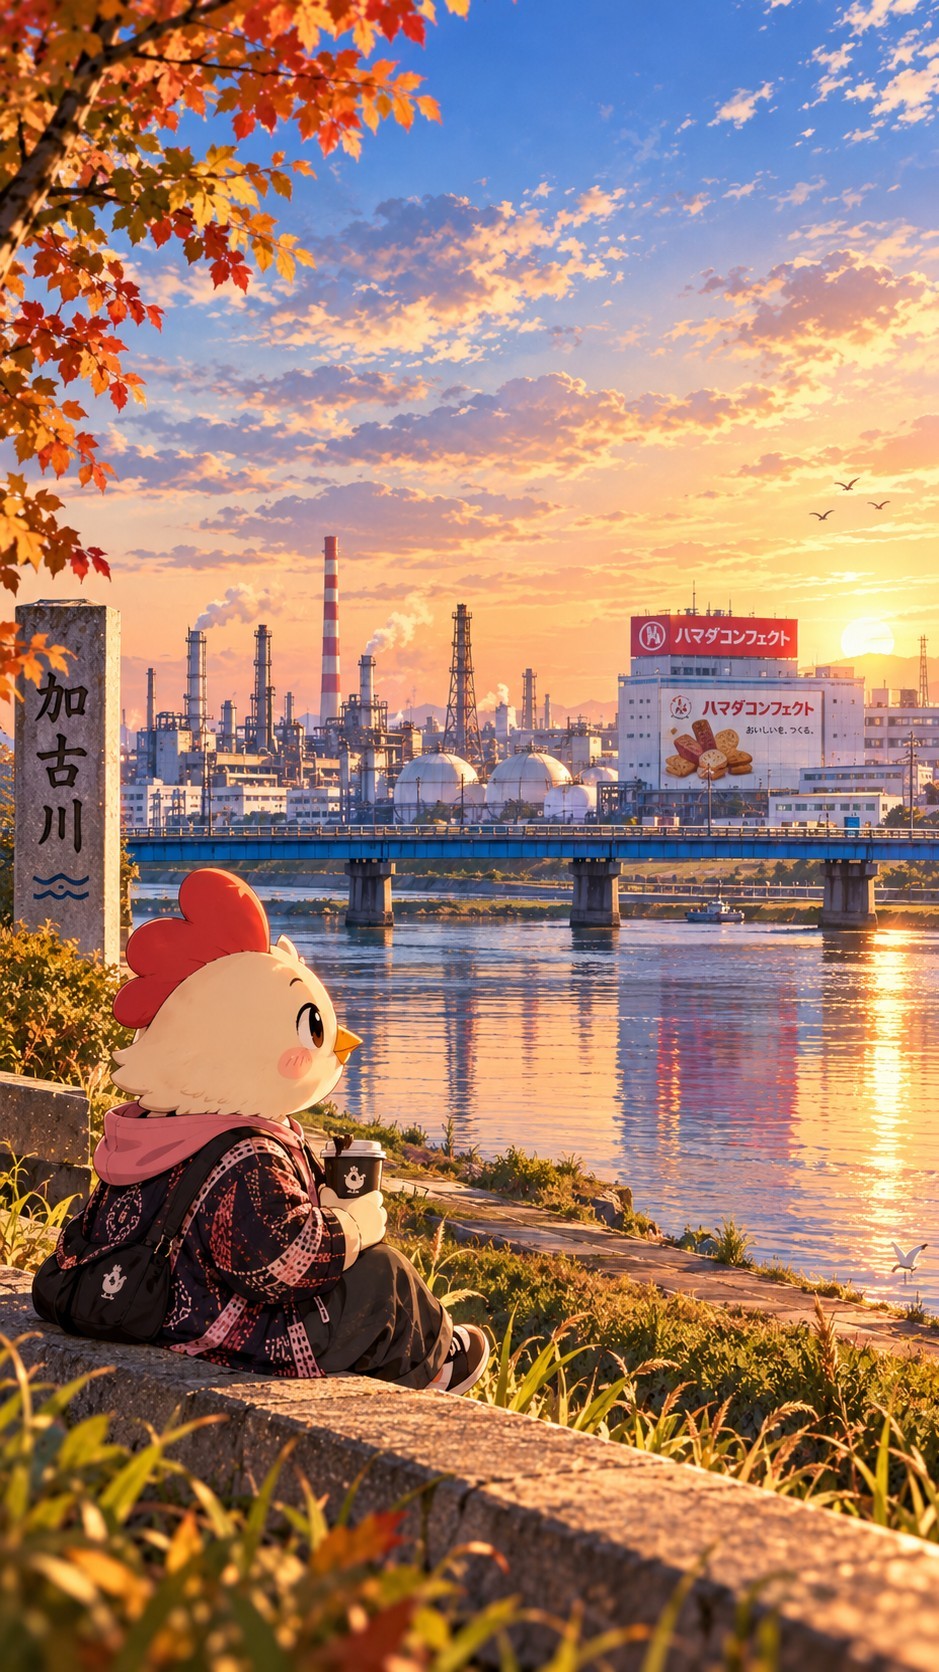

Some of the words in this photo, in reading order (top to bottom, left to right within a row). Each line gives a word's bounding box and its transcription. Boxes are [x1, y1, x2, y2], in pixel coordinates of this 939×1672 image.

[675, 627, 791, 647] ハマダコンフェクト
[702, 700, 815, 716] ハマダコンフェクト
[35, 672, 89, 853] 加古川
